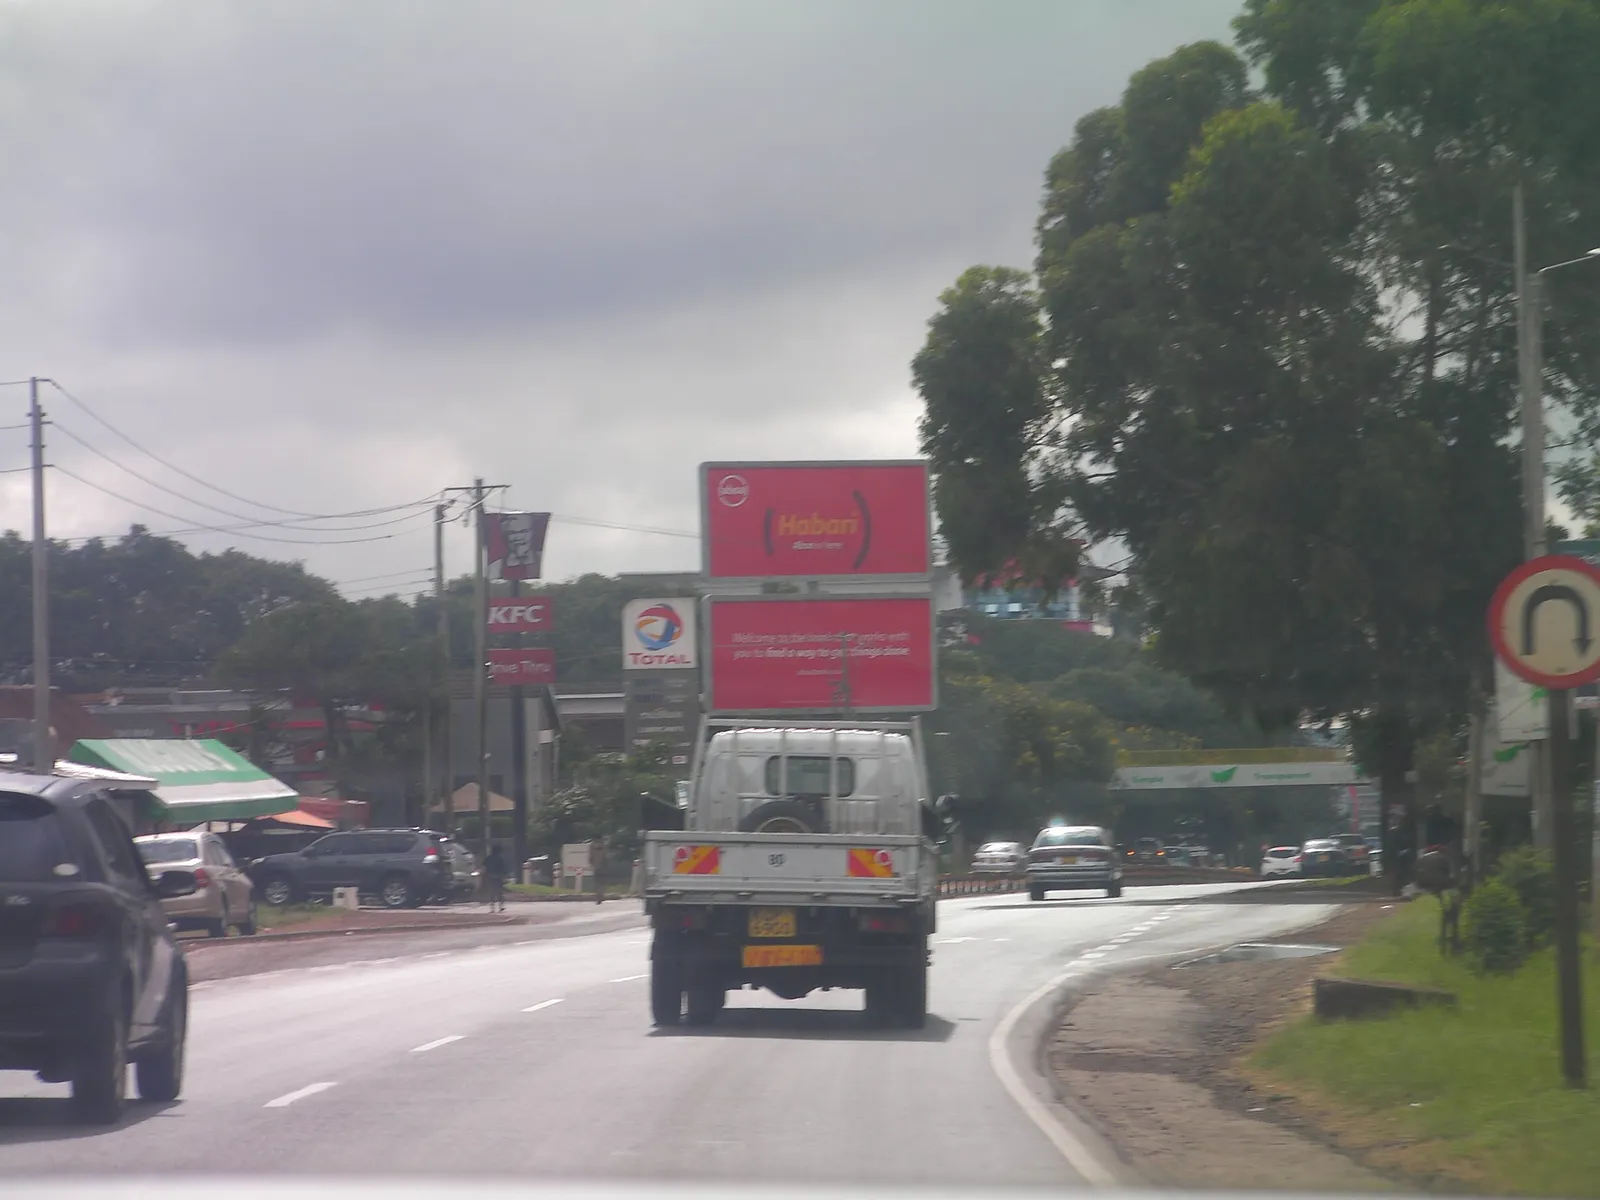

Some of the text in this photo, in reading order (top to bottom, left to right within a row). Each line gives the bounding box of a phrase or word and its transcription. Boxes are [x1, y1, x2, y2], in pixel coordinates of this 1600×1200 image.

[779, 512, 859, 536] Habari
[488, 605, 545, 625] KFC
[629, 653, 691, 665] TOTAL
[766, 648, 786, 659] find
[797, 651, 816, 661] way
